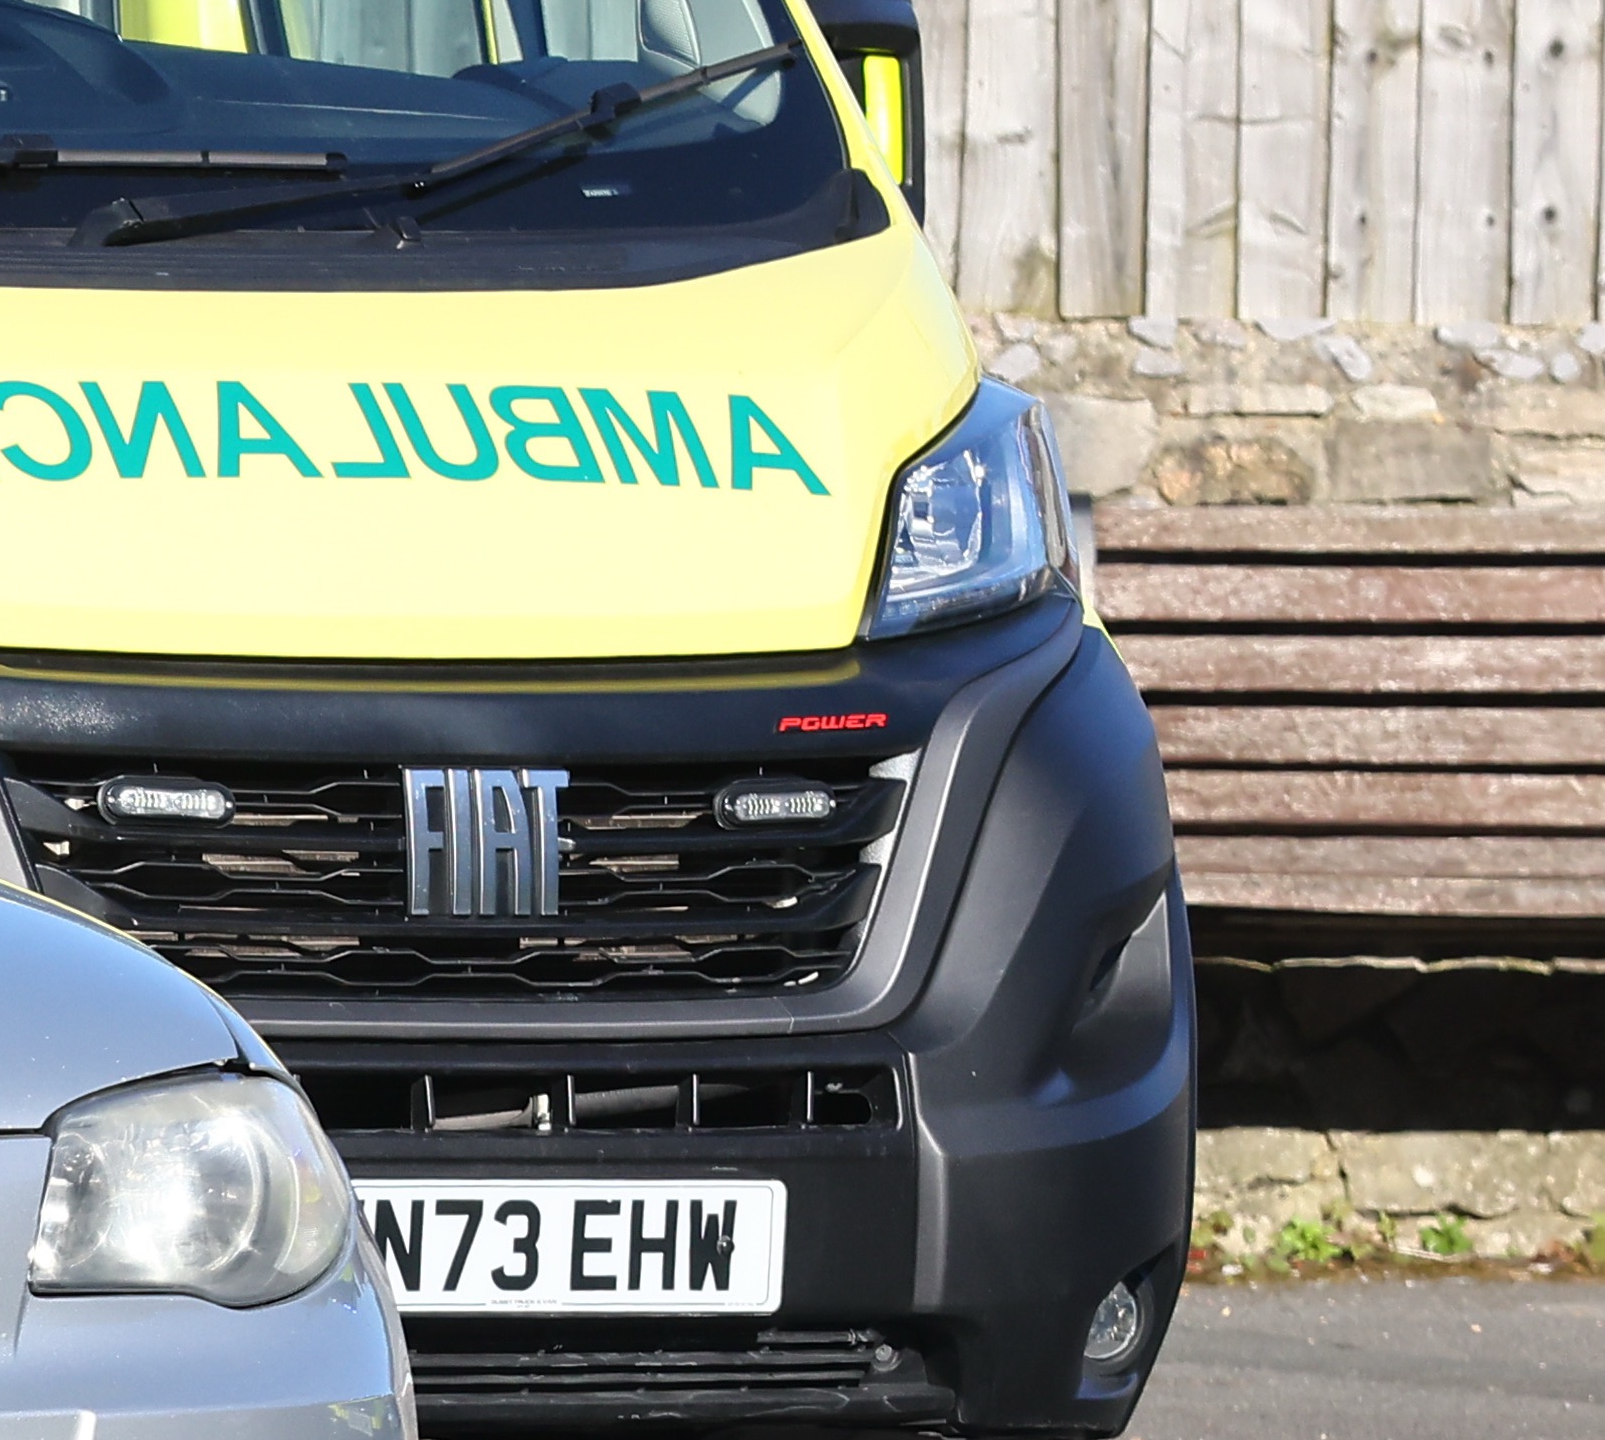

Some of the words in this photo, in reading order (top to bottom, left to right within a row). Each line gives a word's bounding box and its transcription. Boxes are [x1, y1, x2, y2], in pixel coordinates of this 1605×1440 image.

[777, 712, 887, 733] POWER
[403, 767, 571, 916] FIAT
[359, 1199, 541, 1292] N73
[570, 1199, 737, 1292] EHW
